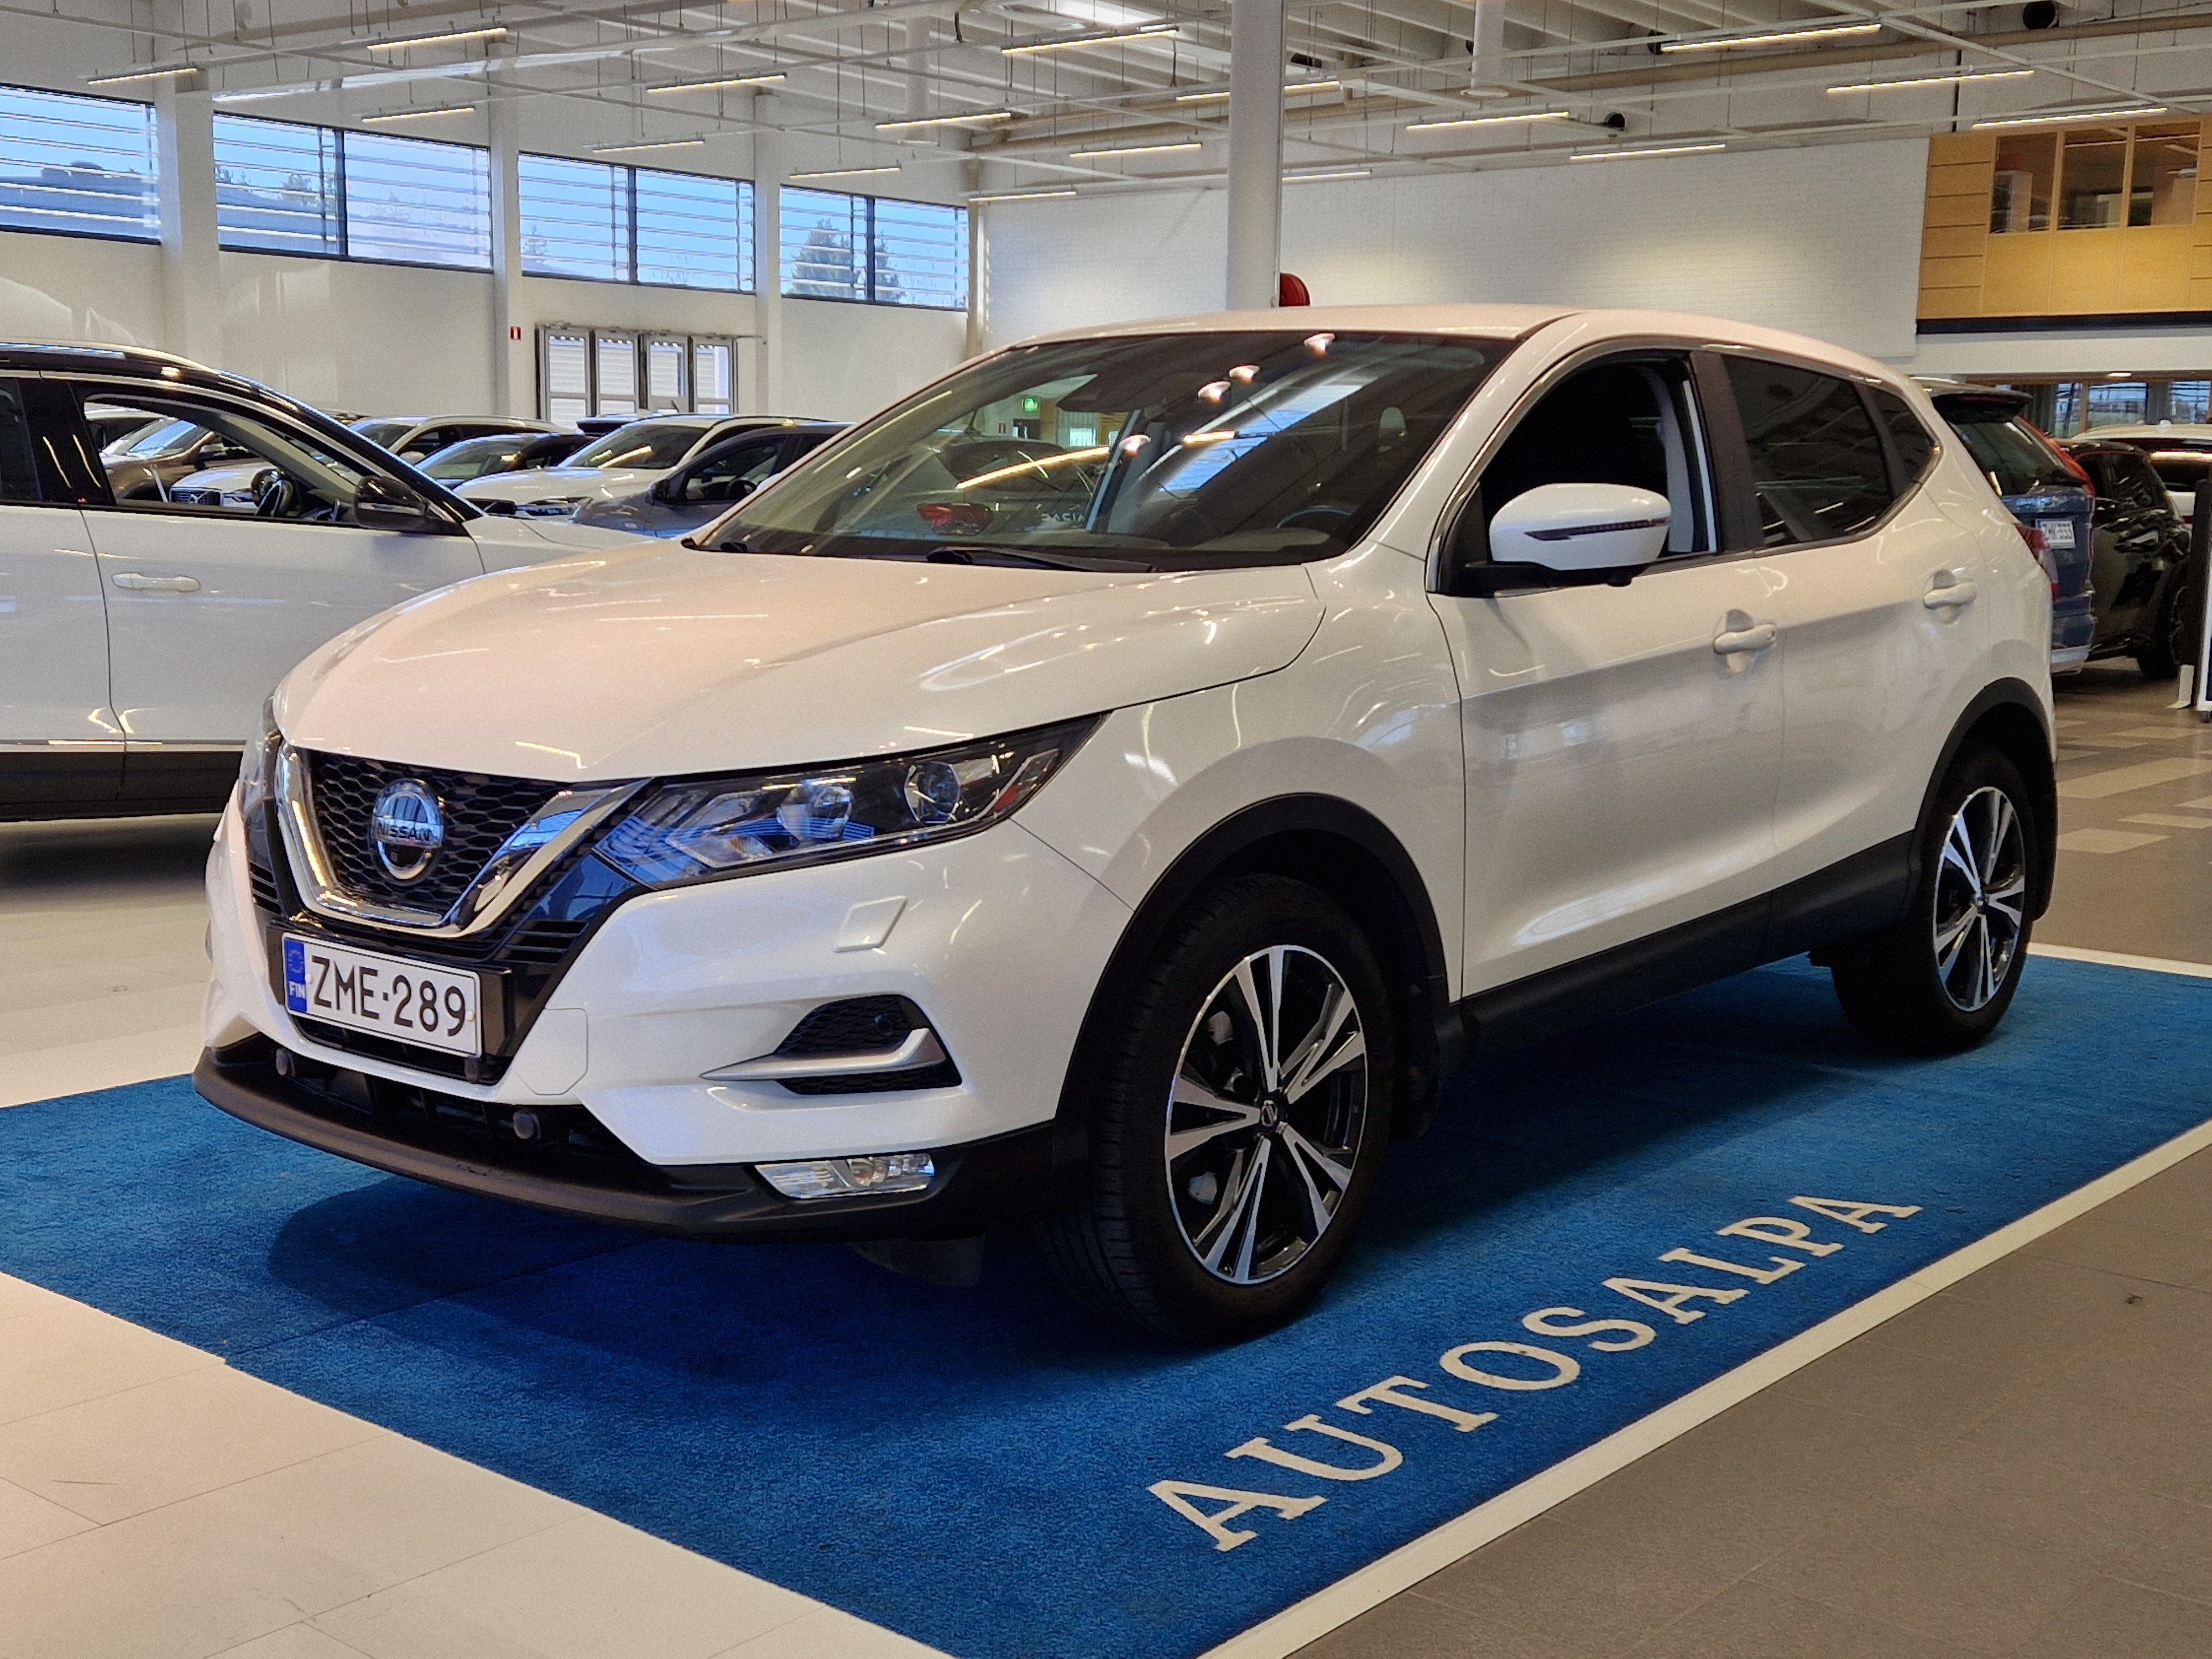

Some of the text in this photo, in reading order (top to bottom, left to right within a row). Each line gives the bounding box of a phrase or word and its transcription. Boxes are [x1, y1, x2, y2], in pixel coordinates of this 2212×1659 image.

[376, 820, 430, 842] NISSAN
[289, 982, 305, 999] FIN
[311, 954, 466, 1037] ZME-289
[1146, 1194, 1924, 1553] AUTOSALPA
